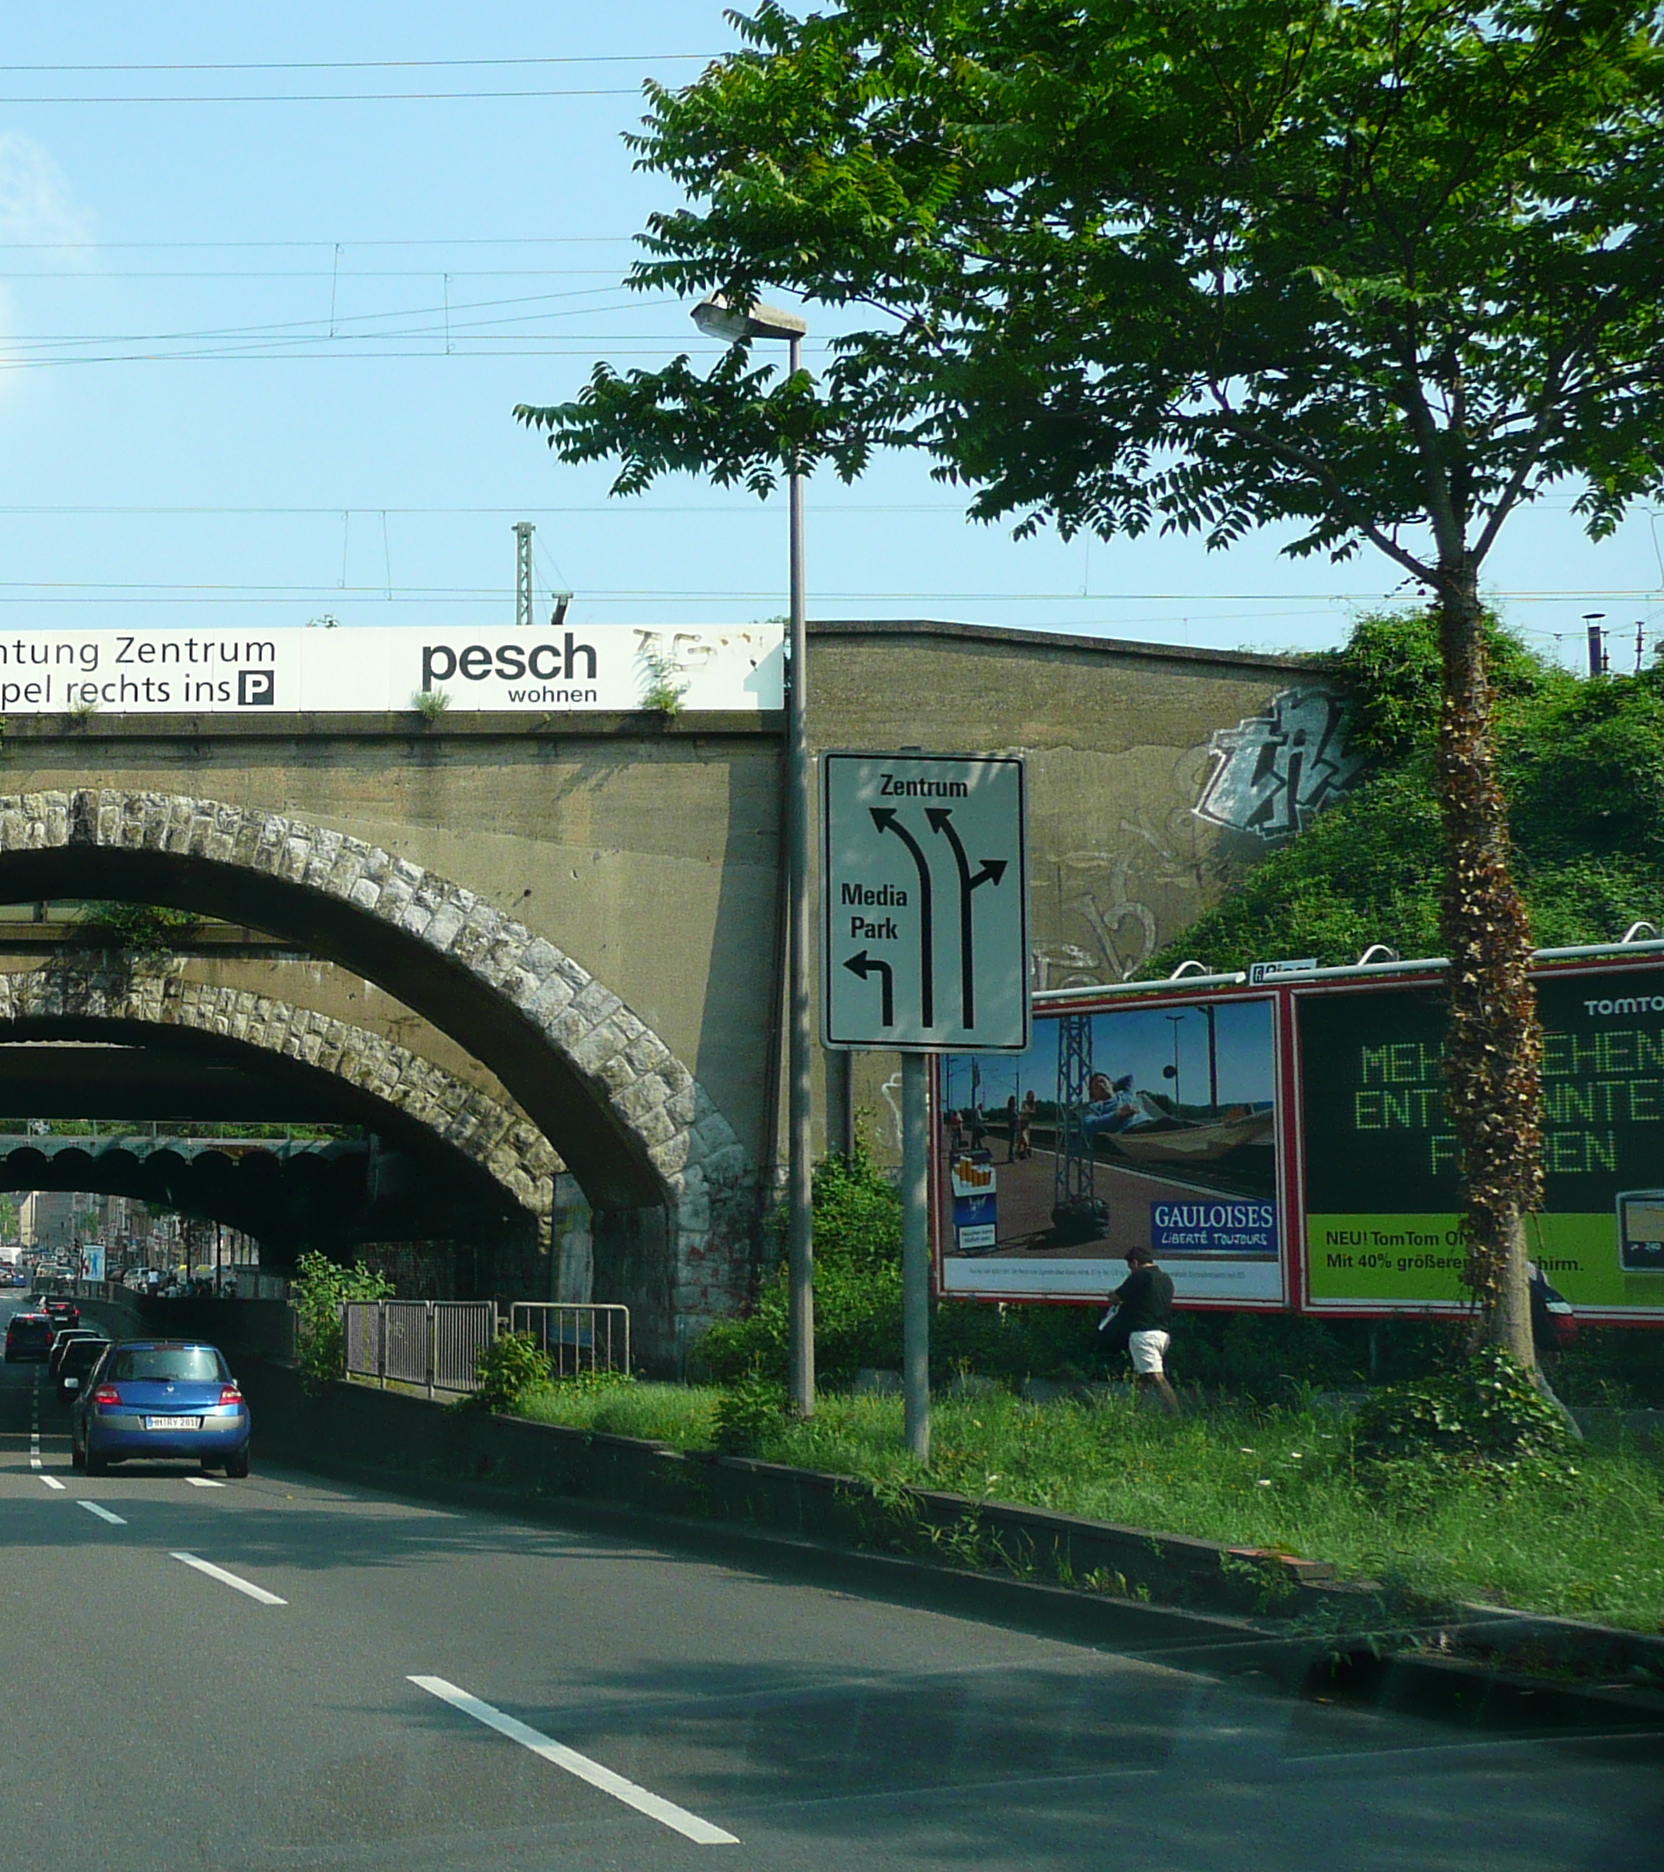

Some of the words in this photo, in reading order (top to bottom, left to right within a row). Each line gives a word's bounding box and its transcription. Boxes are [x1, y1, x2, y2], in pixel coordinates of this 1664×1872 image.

[115, 637, 276, 664] Zentrum
[422, 632, 597, 692] pesch
[67, 673, 171, 704] rechts
[184, 673, 231, 703] ins
[508, 686, 597, 703] wohnen
[880, 774, 968, 798] Zentrum
[841, 883, 908, 907] Media
[850, 917, 898, 940] Park
[1584, 996, 1664, 1016] TOMTO
[1542, 1029, 1664, 1075] EHEN
[1155, 1205, 1273, 1228] GAULOISES
[1212, 1233, 1267, 1246] TOUJOURS
[1326, 1231, 1367, 1245] NEU!
[1370, 1231, 1440, 1246] TomTom
[1327, 1253, 1354, 1268] Mit
[1358, 1253, 1392, 1269] 40%
